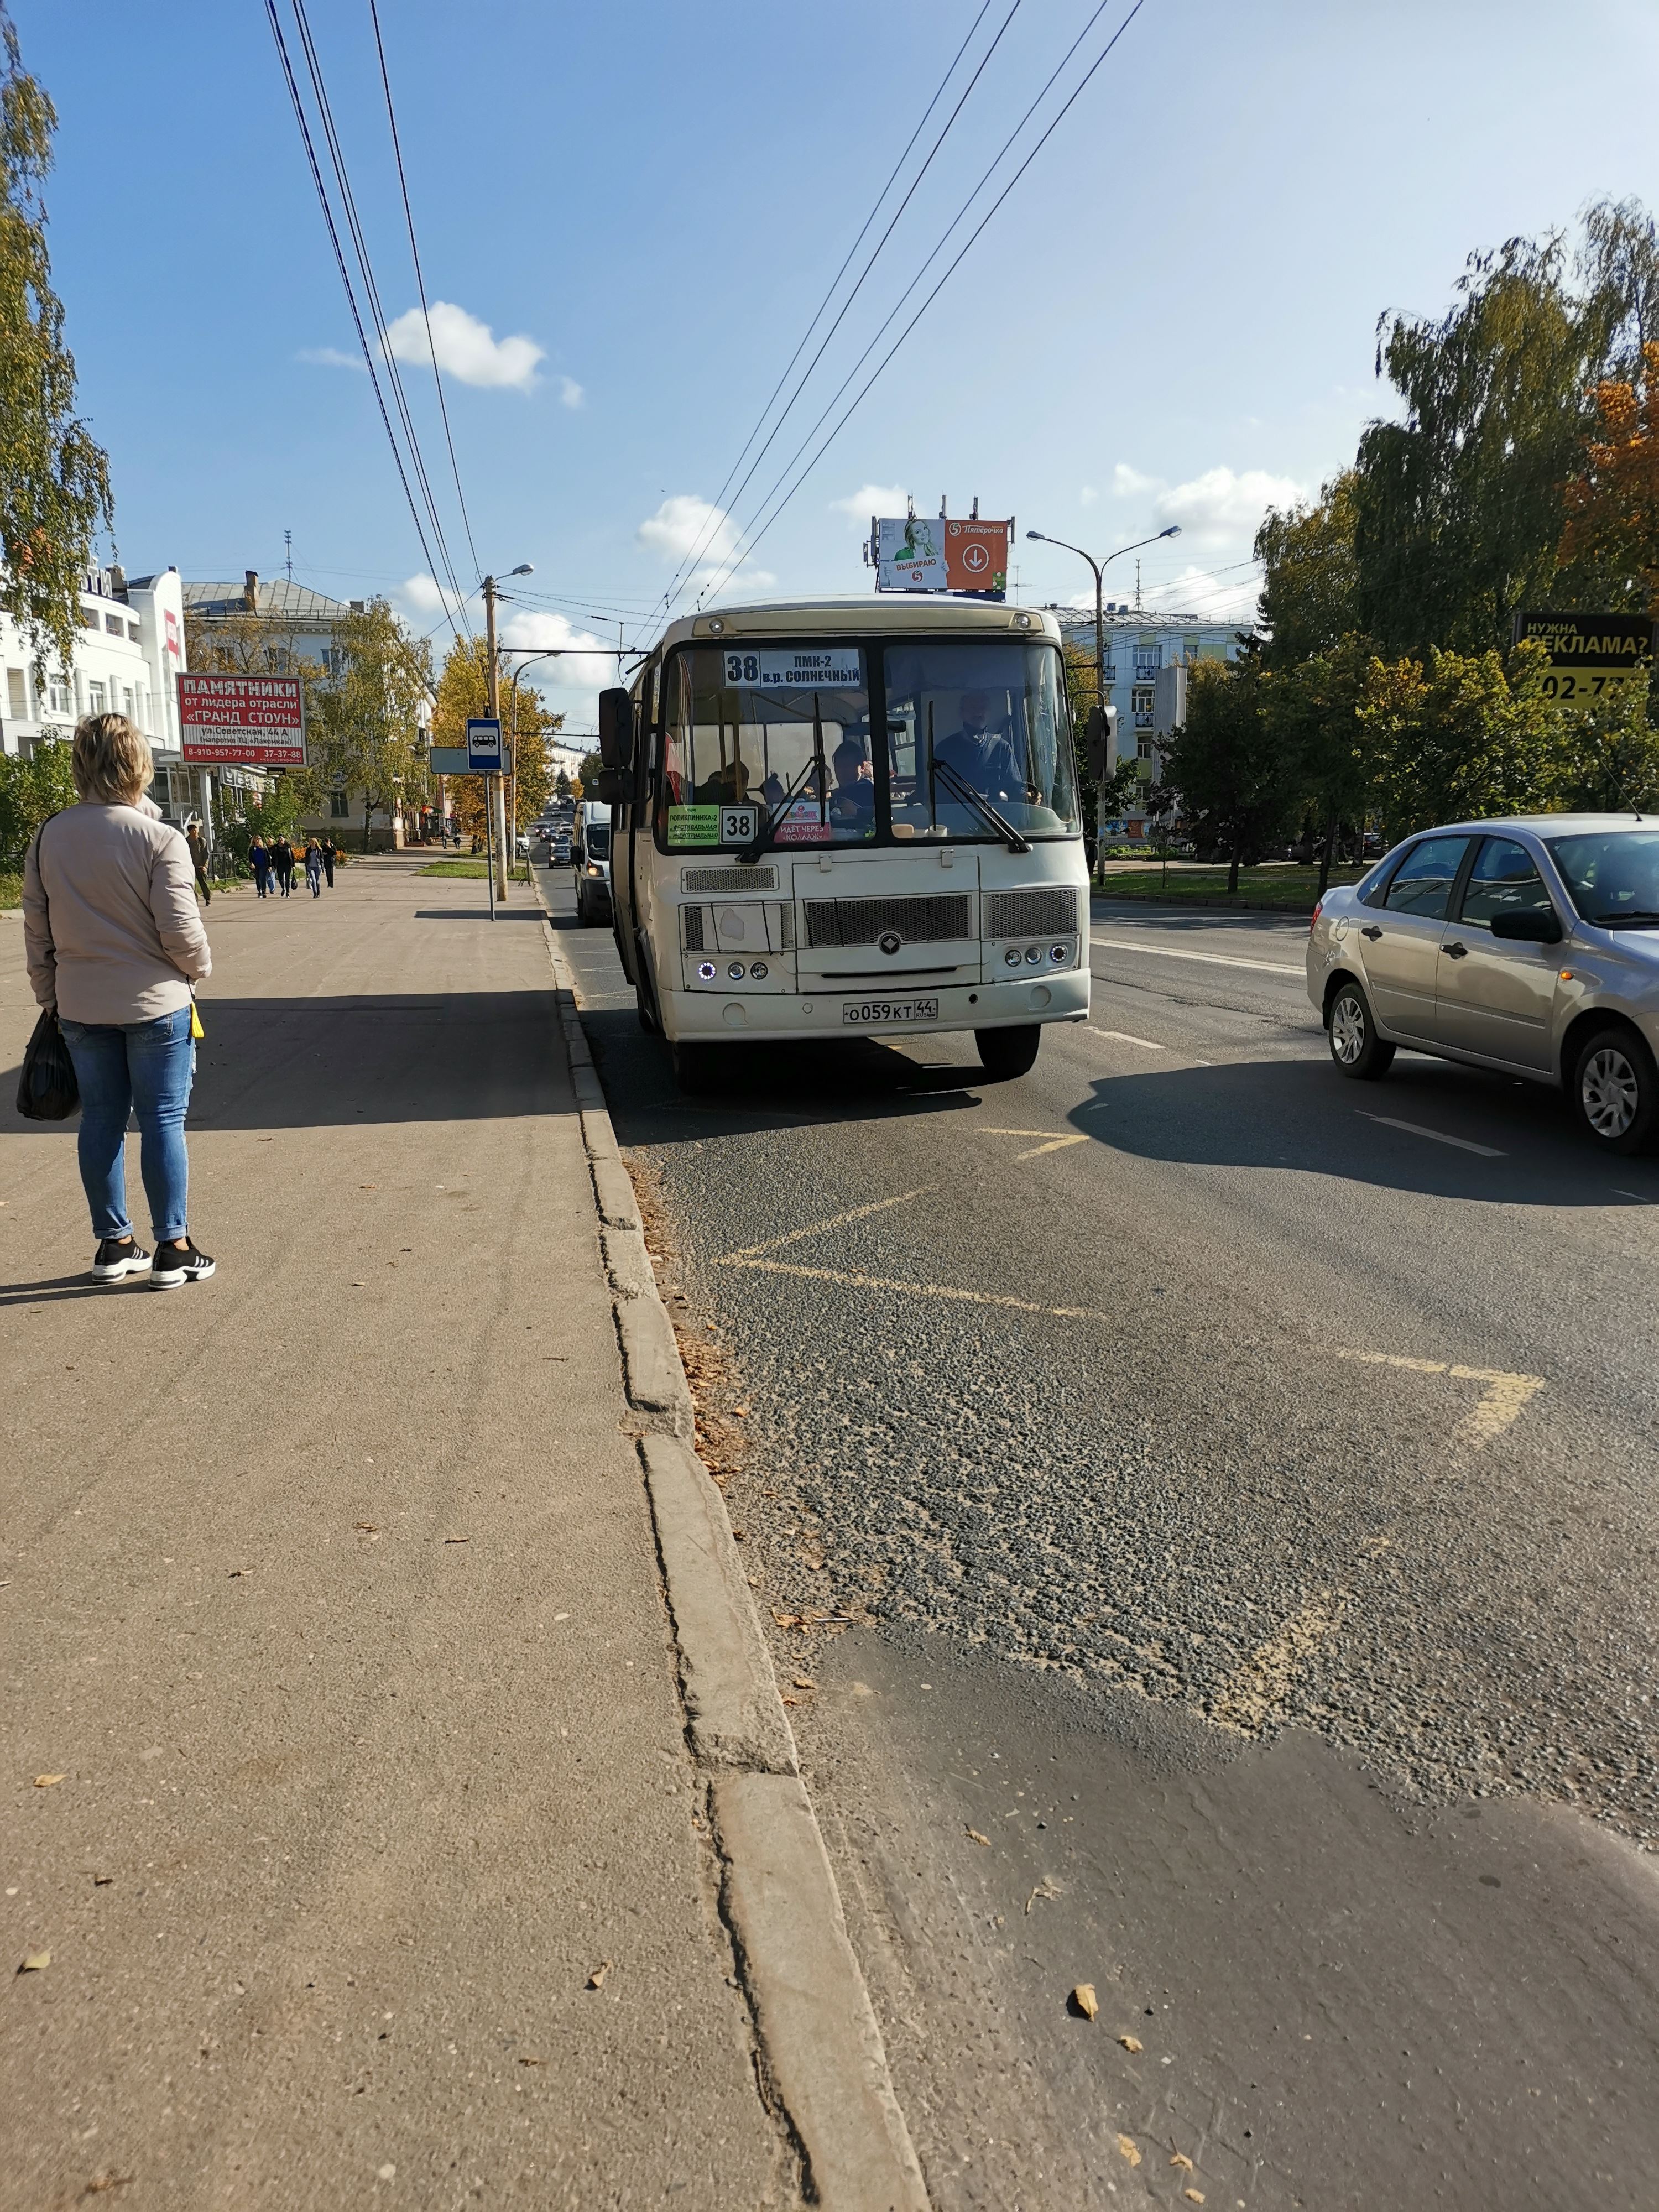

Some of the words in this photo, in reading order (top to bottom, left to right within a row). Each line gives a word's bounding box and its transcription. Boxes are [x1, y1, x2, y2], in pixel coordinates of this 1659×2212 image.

[896, 559, 936, 571] ВЫБИРАЮ
[1527, 623, 1577, 634] НУЖНА
[794, 655, 832, 667] ПМК-2
[727, 656, 758, 681] 38
[763, 671, 784, 684] в.р.
[786, 667, 860, 681] СОЛНЕЧНЫЙ
[183, 679, 297, 697] ПАМЯТНИКИ
[201, 698, 246, 709] лидера
[249, 701, 297, 711] отрасли
[186, 710, 241, 725] «ГРАНД
[248, 712, 299, 725] СТОУН»
[281, 728, 288, 736] А
[188, 748, 255, 757] 8-910-957-77-00
[726, 815, 750, 836] 38
[780, 825, 800, 833] ИДЁТ
[849, 1005, 912, 1021] О059КТ
[916, 1001, 932, 1013] 44
